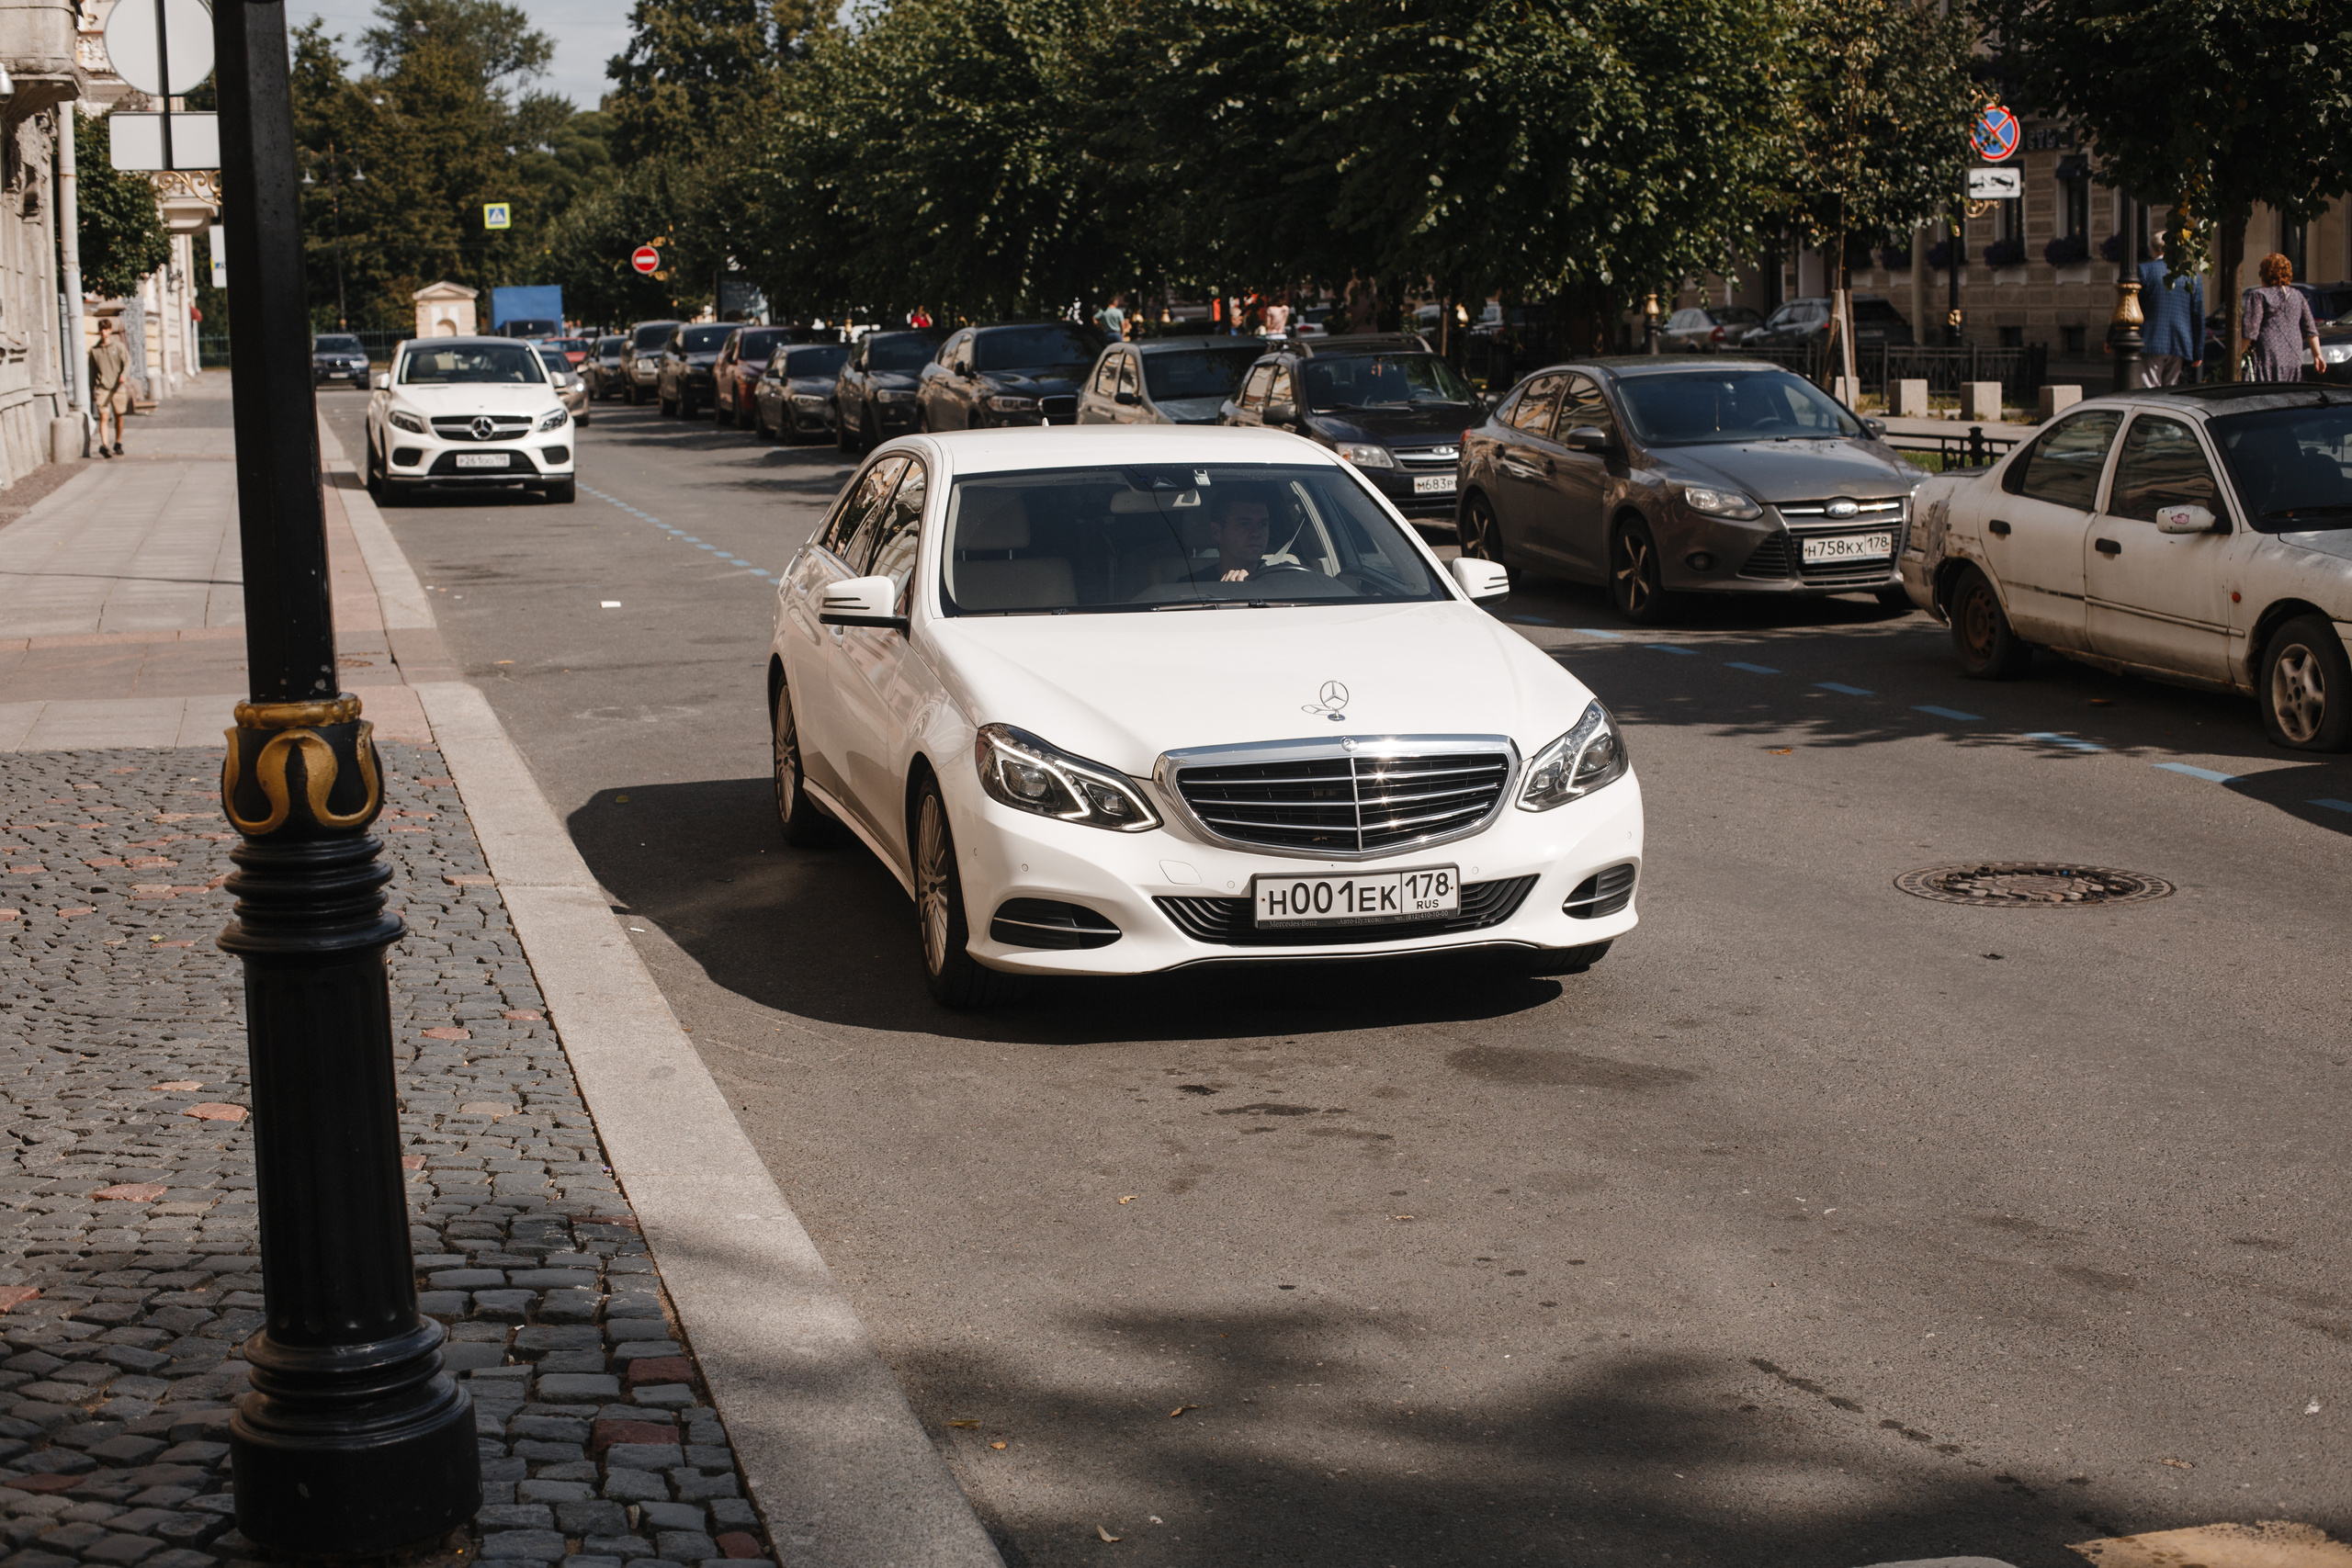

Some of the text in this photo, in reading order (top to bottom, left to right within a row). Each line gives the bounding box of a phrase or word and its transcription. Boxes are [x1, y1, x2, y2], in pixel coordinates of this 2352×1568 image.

[1418, 478, 1457, 491] М683Р
[1808, 540, 1863, 557] Н758КХ
[1867, 536, 1887, 548] 178
[1269, 872, 1449, 915] Н001ЕК 178
[1417, 899, 1439, 910] RUS
[1269, 919, 1317, 928] Mercedes-Benz
